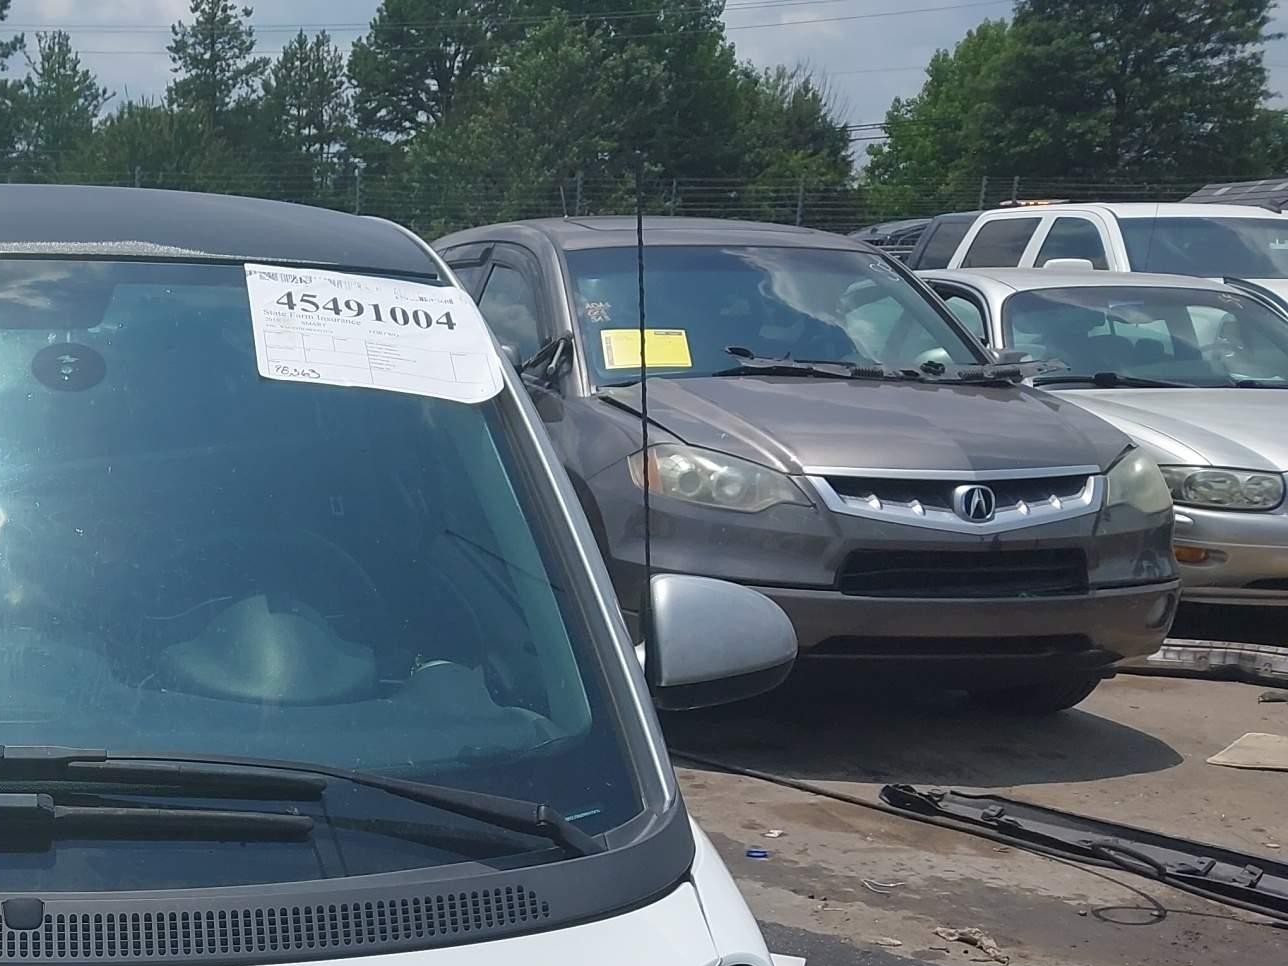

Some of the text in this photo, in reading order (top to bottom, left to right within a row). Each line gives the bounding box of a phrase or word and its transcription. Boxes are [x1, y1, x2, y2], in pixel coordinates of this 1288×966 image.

[263, 309, 362, 327] State Farm Insurance
[276, 291, 457, 330] 45491004
